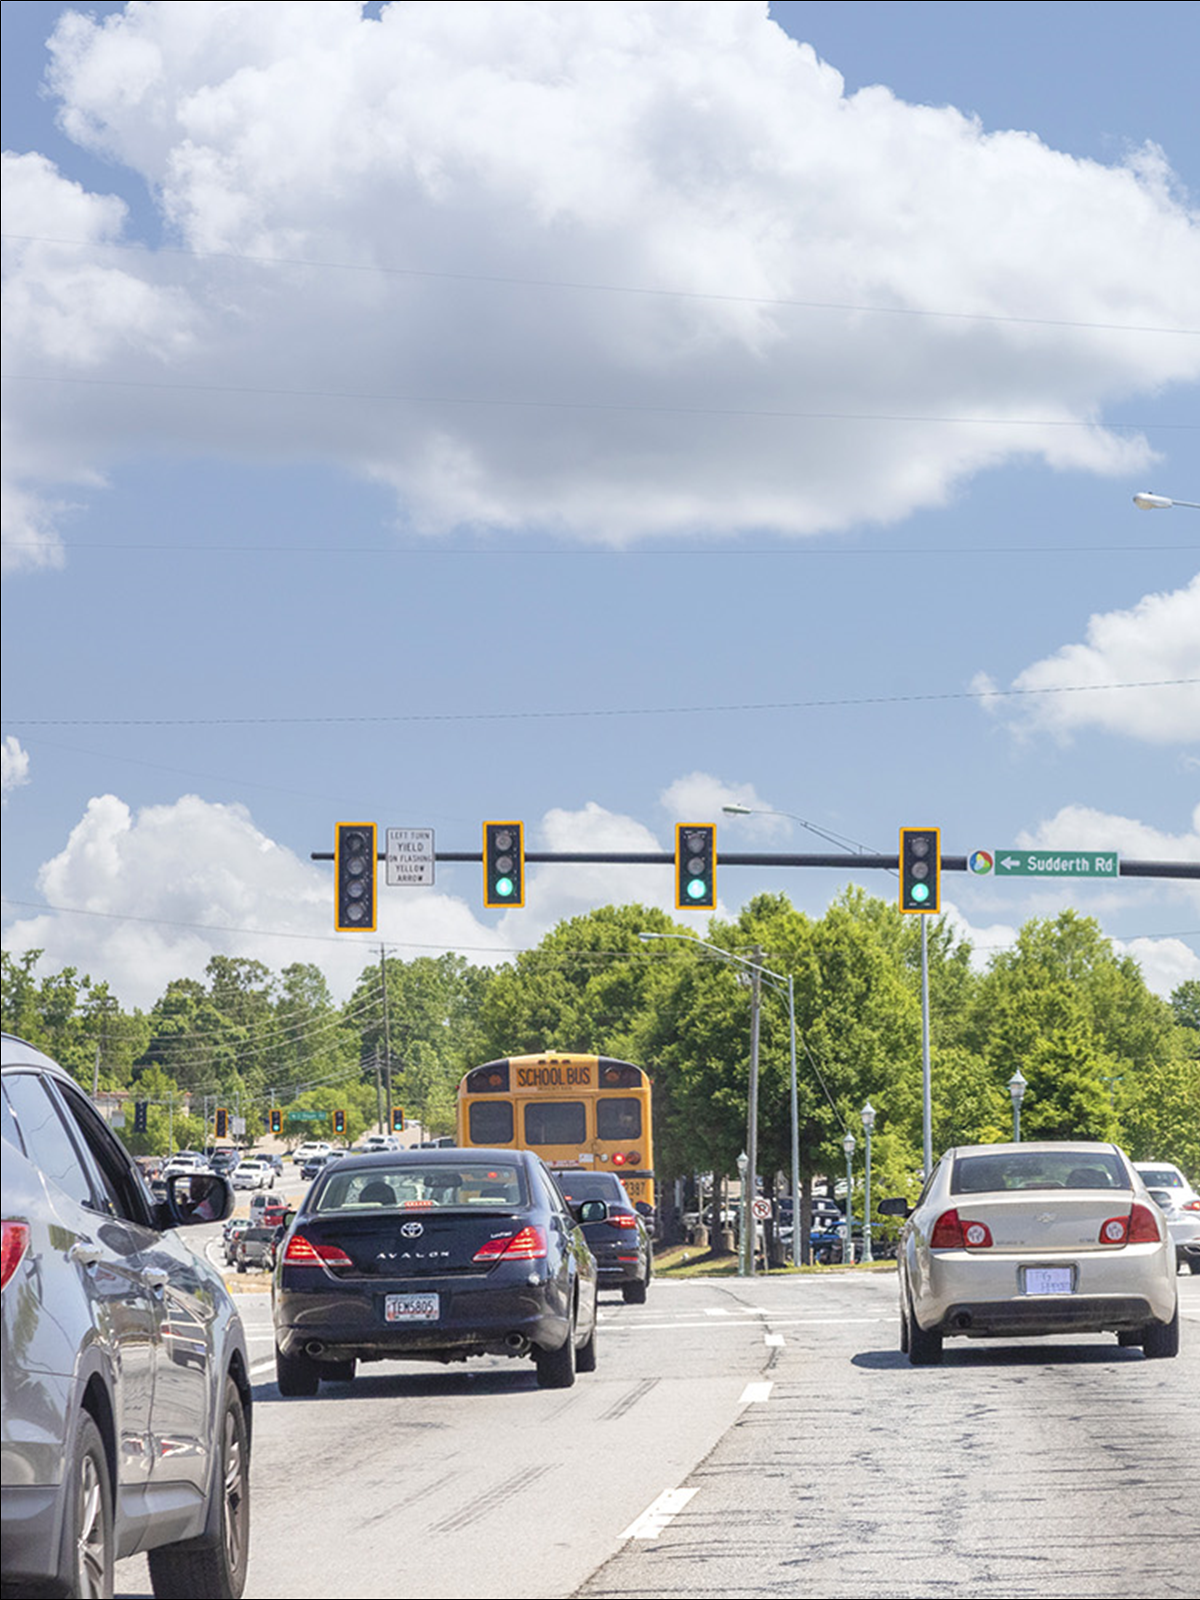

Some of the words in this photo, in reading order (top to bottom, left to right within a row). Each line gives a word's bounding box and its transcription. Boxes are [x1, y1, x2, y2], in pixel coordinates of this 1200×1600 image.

[390, 831, 408, 840] LEFT
[410, 831, 430, 840] TURN
[397, 842, 424, 852] YIELD
[389, 855, 398, 863] ON
[1027, 856, 1090, 871] Sudderth
[1095, 857, 1113, 872] Rd
[396, 865, 425, 873] YELLOW
[518, 1068, 565, 1087] SCHOOL
[566, 1067, 591, 1085] BUS
[377, 1251, 450, 1260] AVALON
